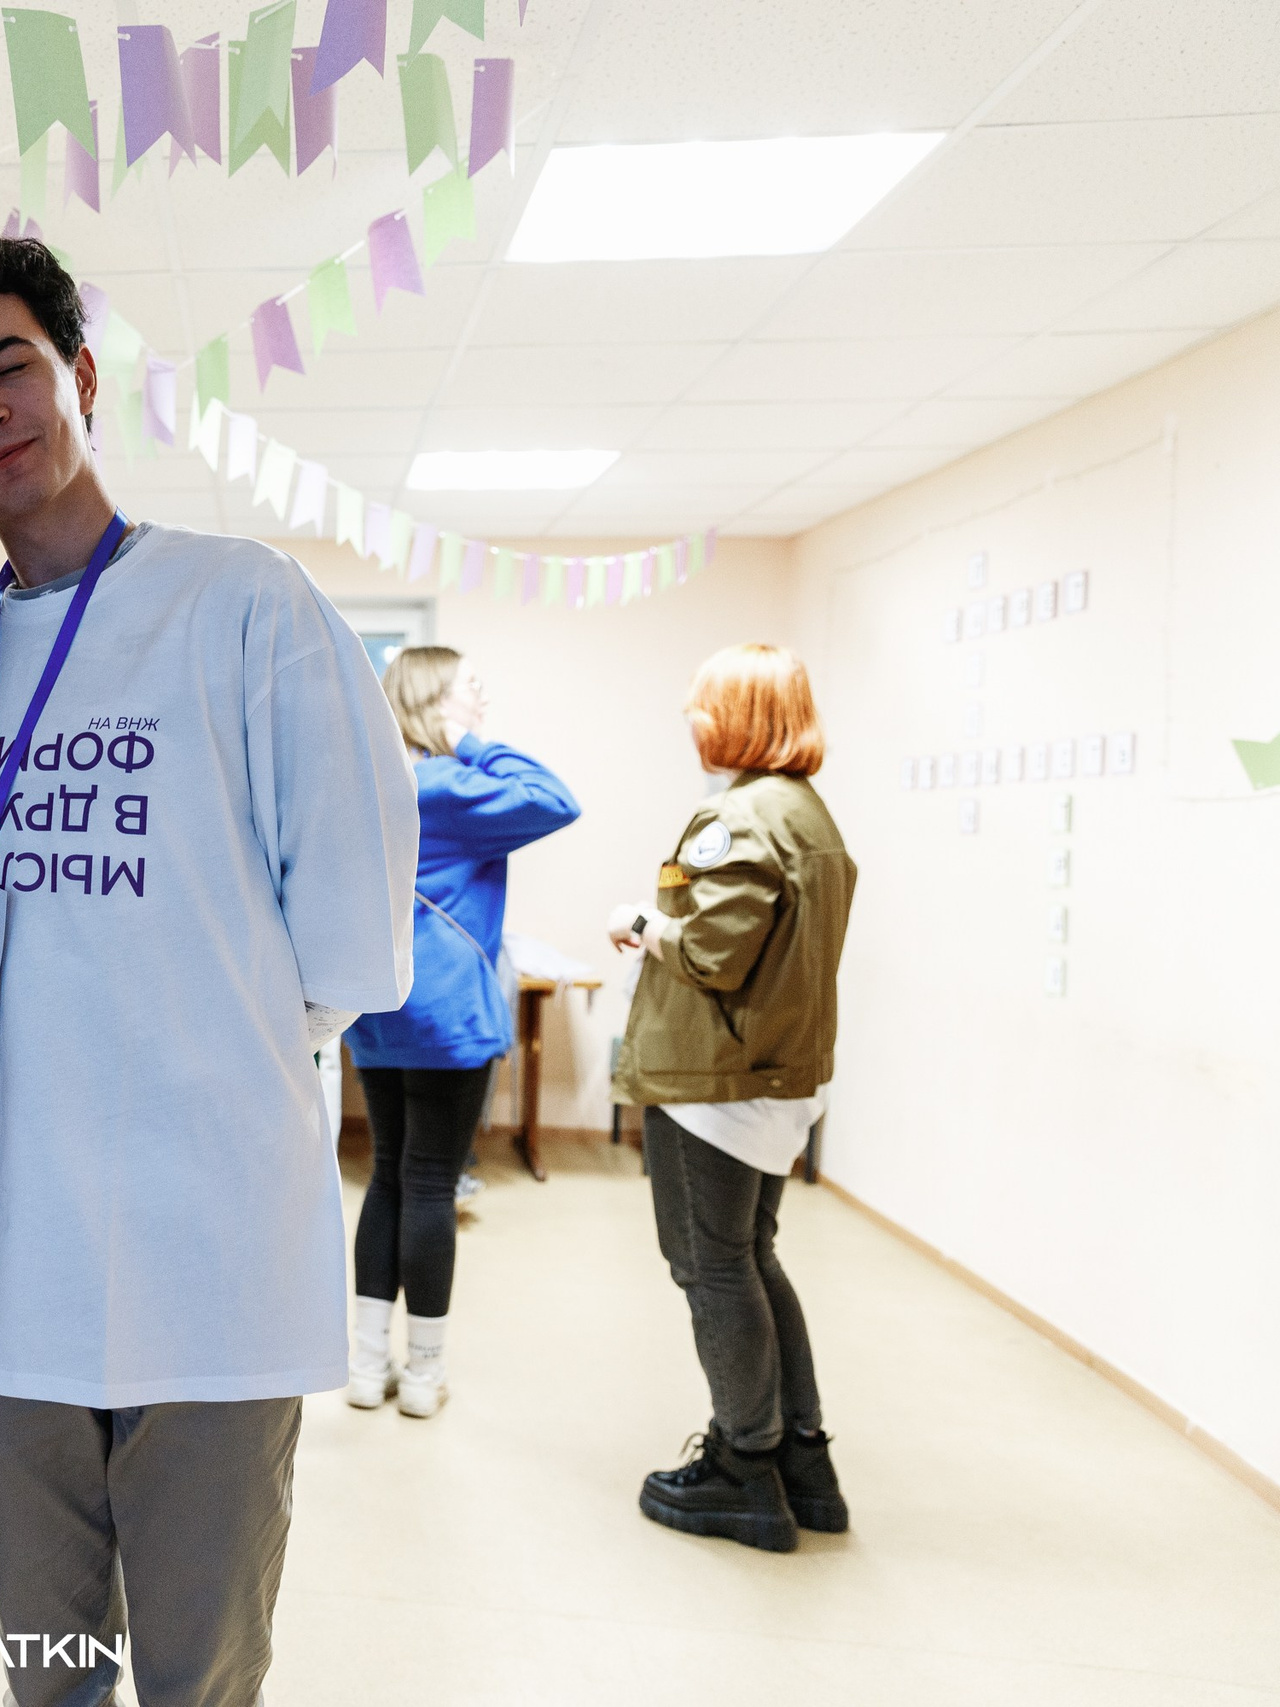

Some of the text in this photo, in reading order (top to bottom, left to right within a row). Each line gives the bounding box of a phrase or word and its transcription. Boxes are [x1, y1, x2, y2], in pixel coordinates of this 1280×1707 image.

[88, 717, 160, 731] НА ВНЖ
[114, 794, 148, 836] В
